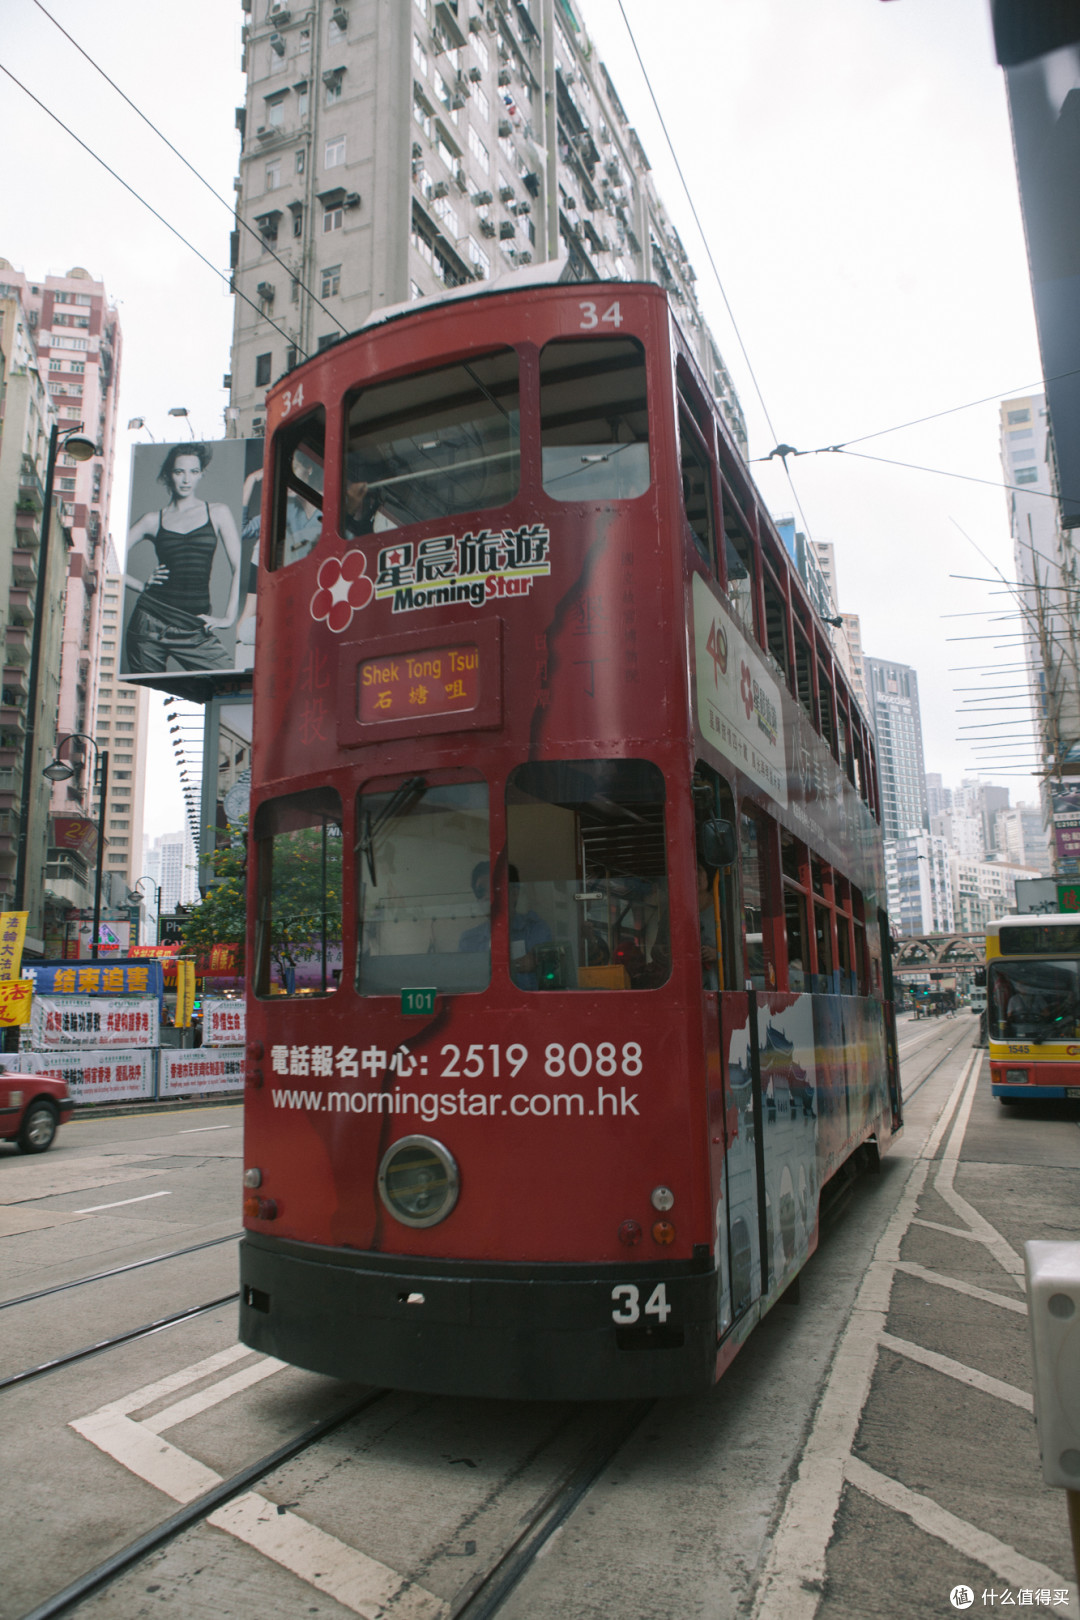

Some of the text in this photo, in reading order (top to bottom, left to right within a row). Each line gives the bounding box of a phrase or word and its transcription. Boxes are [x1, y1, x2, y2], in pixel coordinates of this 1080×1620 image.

[579, 301, 623, 329] 34
[280, 383, 305, 417] 34
[375, 524, 551, 588] 星晨旅遊
[392, 575, 534, 614] MorningStar
[362, 649, 479, 686] Shek Tong Tsui
[373, 680, 467, 709] 石塘咀
[406, 993, 434, 1009] 101
[440, 1043, 530, 1079] 2519
[543, 1041, 644, 1078] 8088
[1008, 1045, 1030, 1054] 1545
[270, 1086, 640, 1122] www.morningstar.com.hk
[611, 1282, 671, 1325] 34
